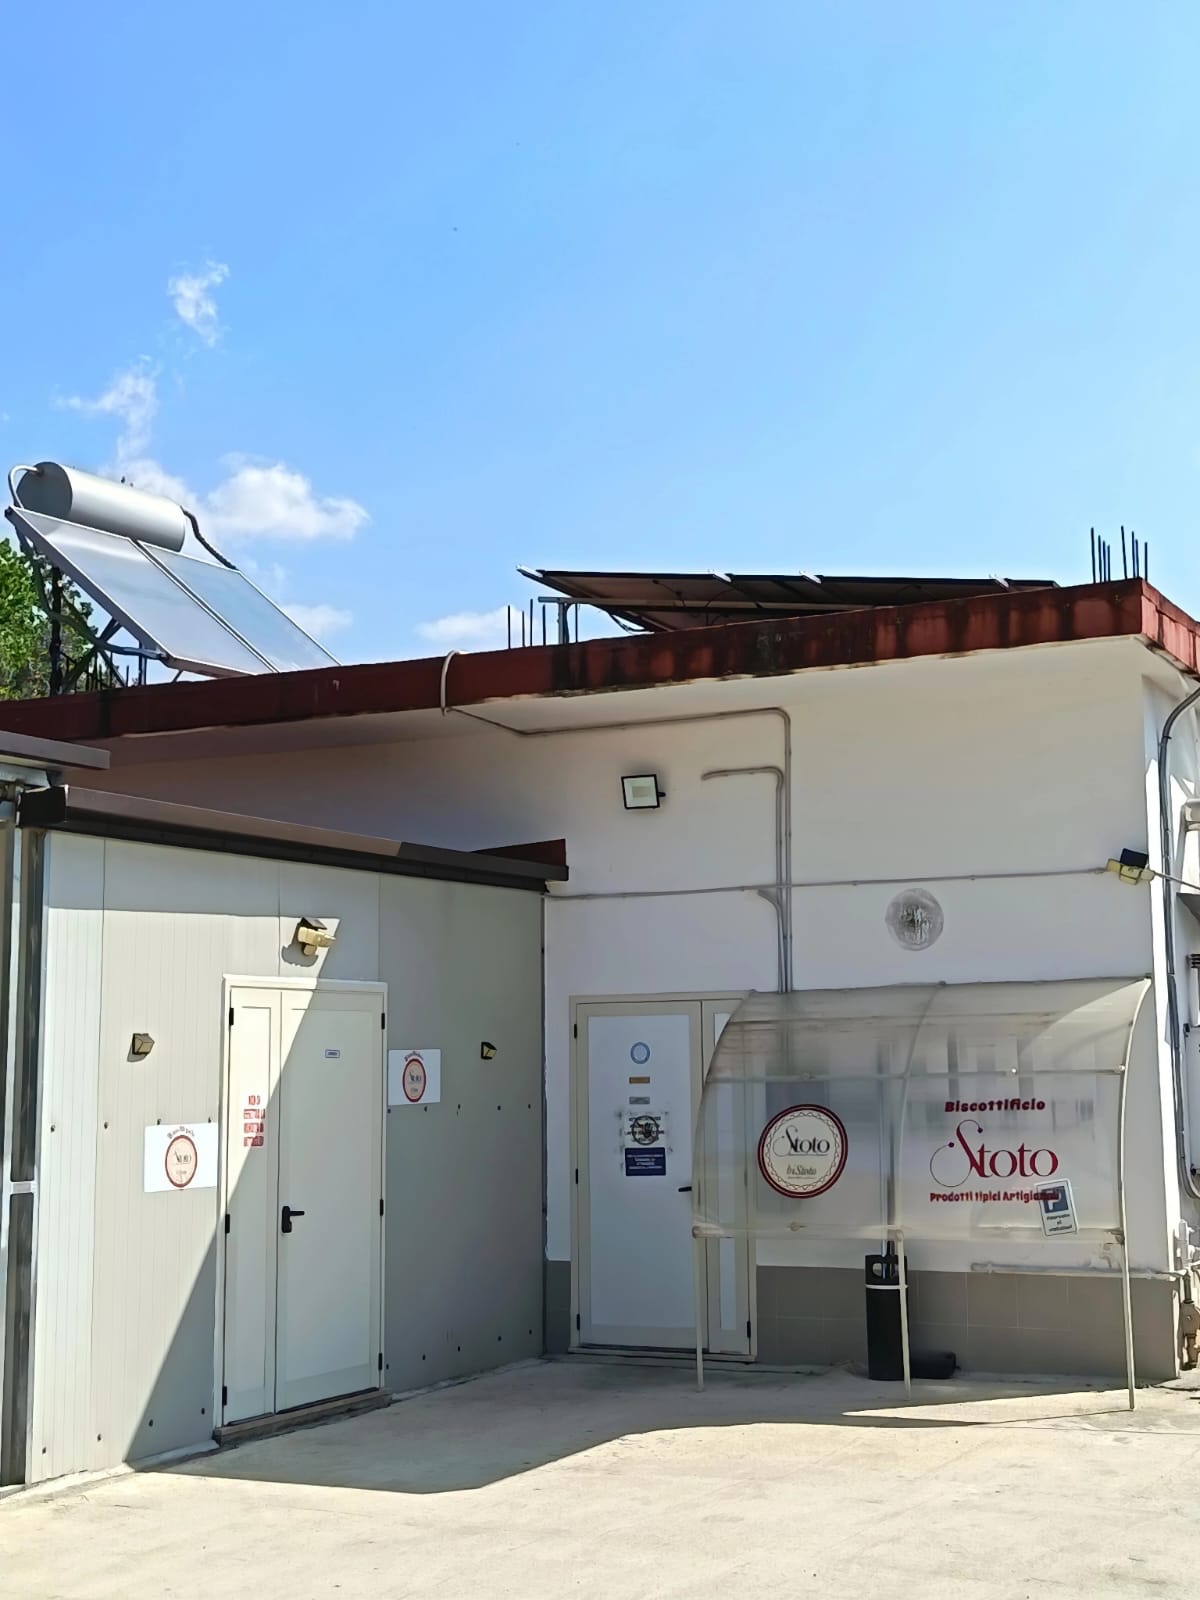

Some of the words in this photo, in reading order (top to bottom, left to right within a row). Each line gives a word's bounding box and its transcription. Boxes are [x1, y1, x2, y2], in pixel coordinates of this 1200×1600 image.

[944, 1098, 1046, 1113] Biscottificio
[930, 1119, 1059, 1187] Stoto
[930, 1191, 973, 1202] Prodotti
[975, 1190, 1001, 1203] tipici
